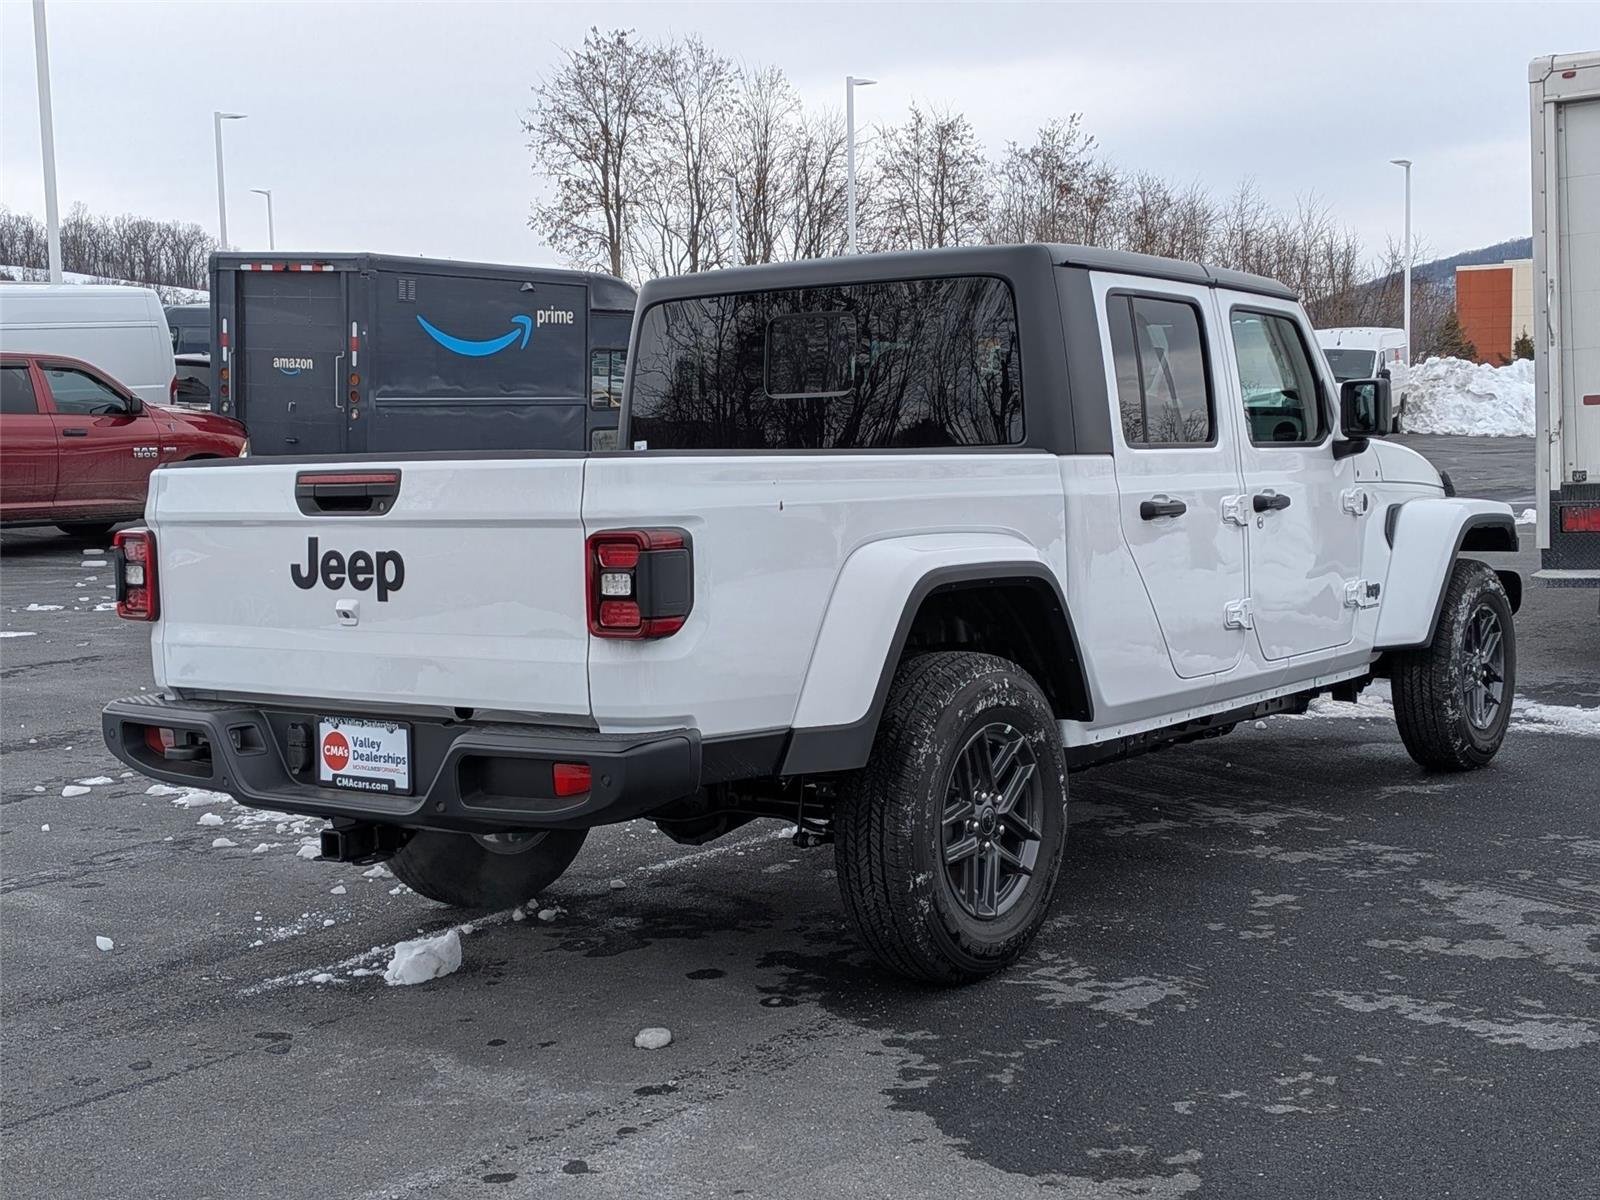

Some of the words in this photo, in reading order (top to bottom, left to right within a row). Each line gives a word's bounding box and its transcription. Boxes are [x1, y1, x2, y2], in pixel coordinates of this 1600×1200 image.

[537, 305, 574, 327] prime
[273, 357, 313, 369] amazon
[290, 536, 405, 602] Jeep
[324, 745, 349, 757] CMA's
[352, 736, 381, 752] Valley
[352, 750, 407, 767] Dealerships
[336, 777, 389, 791] CMAcars.com
